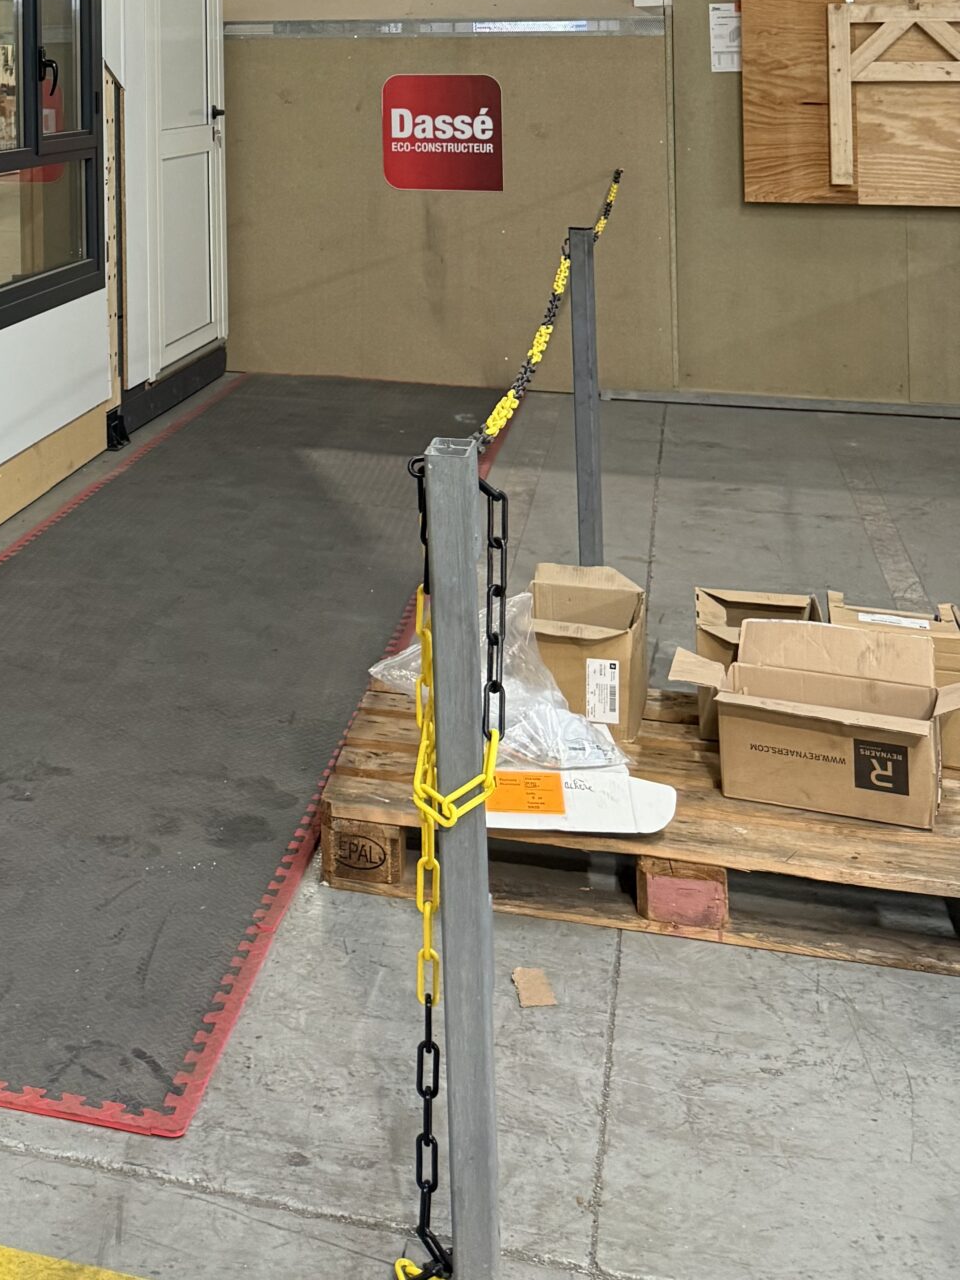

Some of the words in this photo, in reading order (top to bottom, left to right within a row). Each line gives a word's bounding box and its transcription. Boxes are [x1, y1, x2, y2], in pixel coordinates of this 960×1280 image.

[391, 107, 494, 140] Dassé
[391, 141, 494, 154] ECO-CONSTRUCTEUR
[749, 743, 847, 766] WWW.REYNAERS.COM
[859, 748, 903, 761] REYNAERS
[338, 840, 379, 865] EPAL
